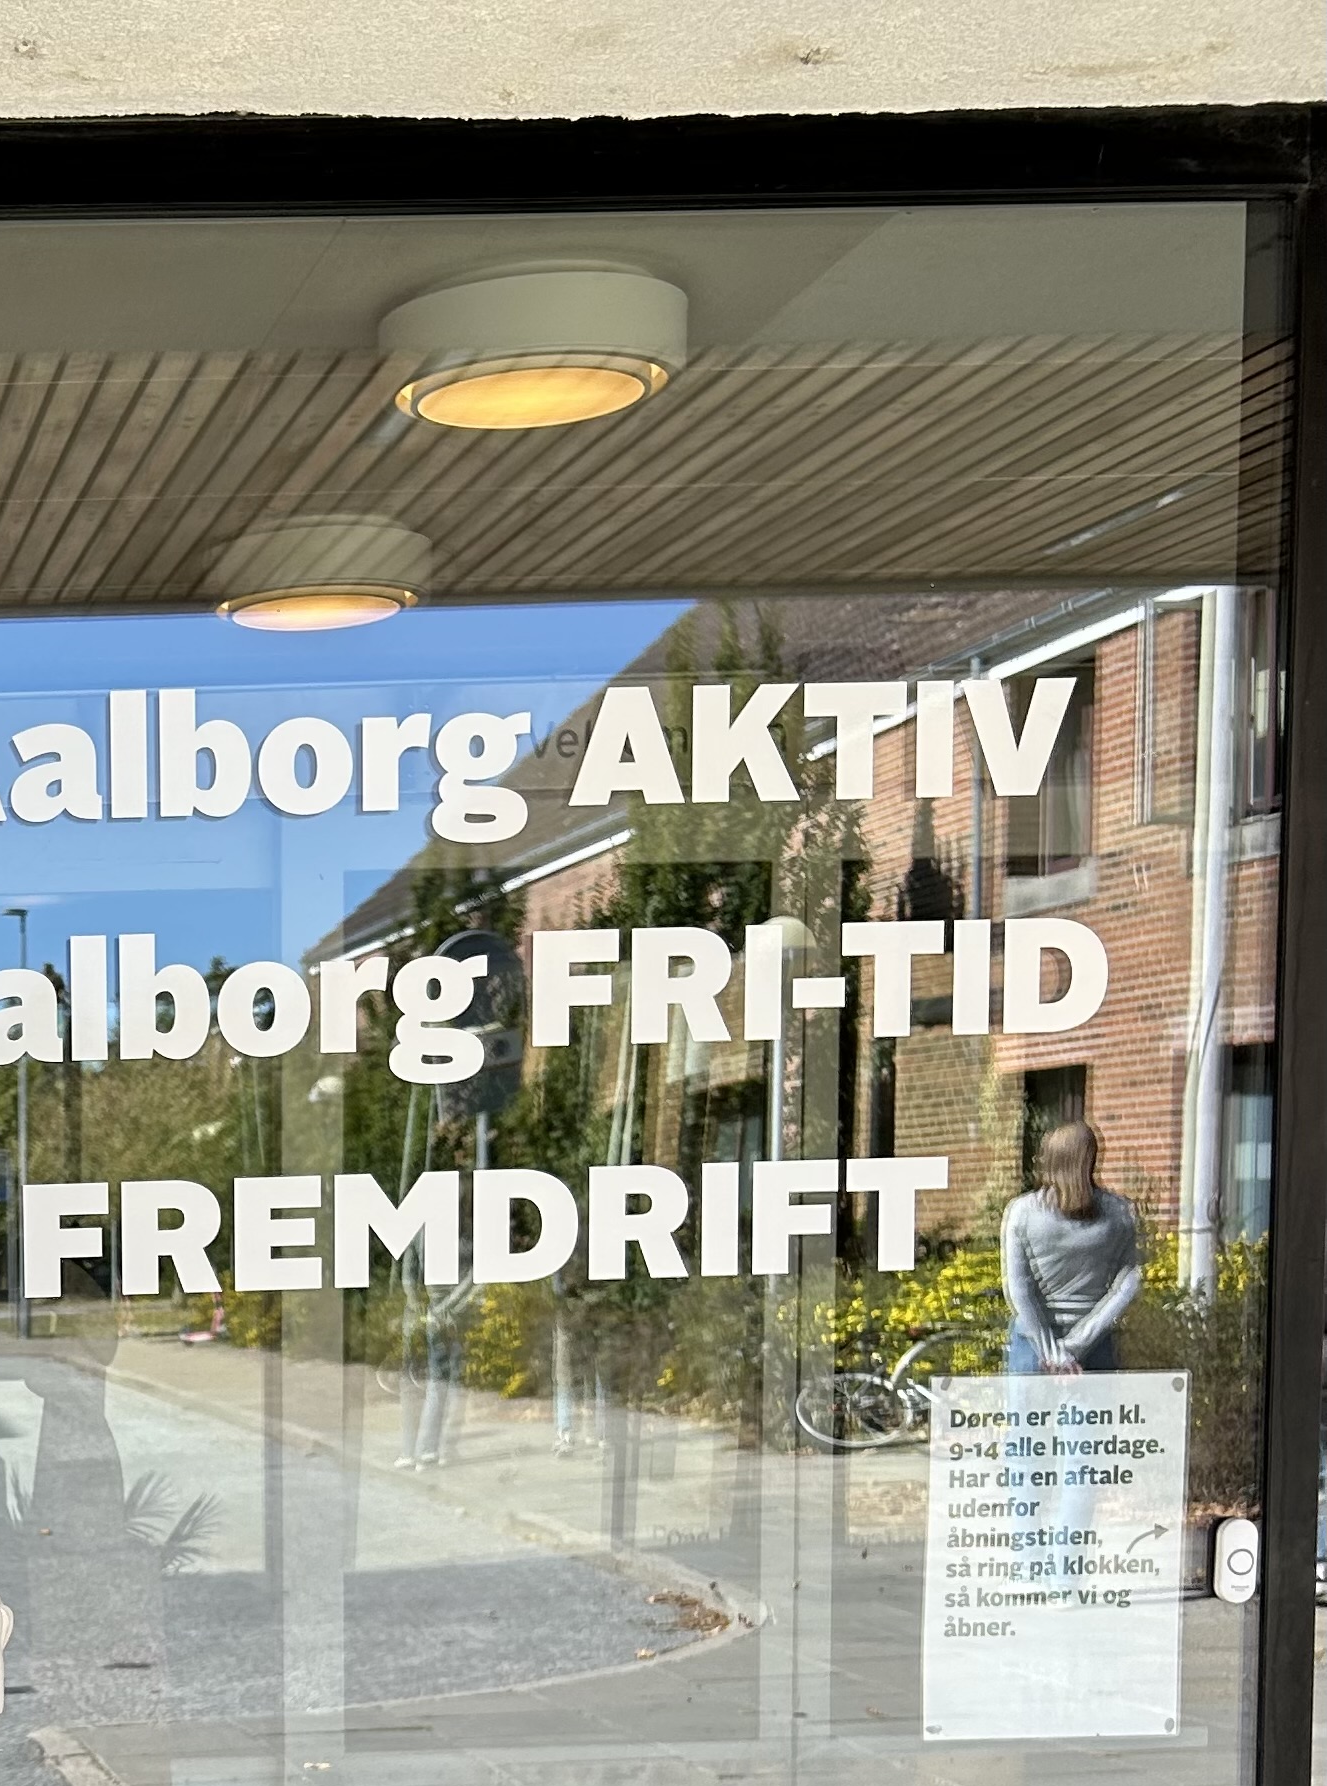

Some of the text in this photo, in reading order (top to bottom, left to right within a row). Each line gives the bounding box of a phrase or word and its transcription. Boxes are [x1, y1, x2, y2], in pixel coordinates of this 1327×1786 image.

[569, 677, 1077, 806] AKTIV
[532, 918, 1110, 1047] FRI-TID
[22, 1157, 949, 1299] FREMDRIFT
[949, 1403, 1146, 1428] Døren er åben kl.
[949, 1435, 1165, 1461] 9-14 alle hverdage.
[949, 1465, 1133, 1488] Har du en aftale
[948, 1497, 1040, 1519] udenfor
[946, 1526, 1103, 1552] åbningstiden,
[945, 1554, 1160, 1581] så ring på klokken,
[944, 1585, 1132, 1609] så kommer vi og
[944, 1615, 1016, 1637] åbner.
